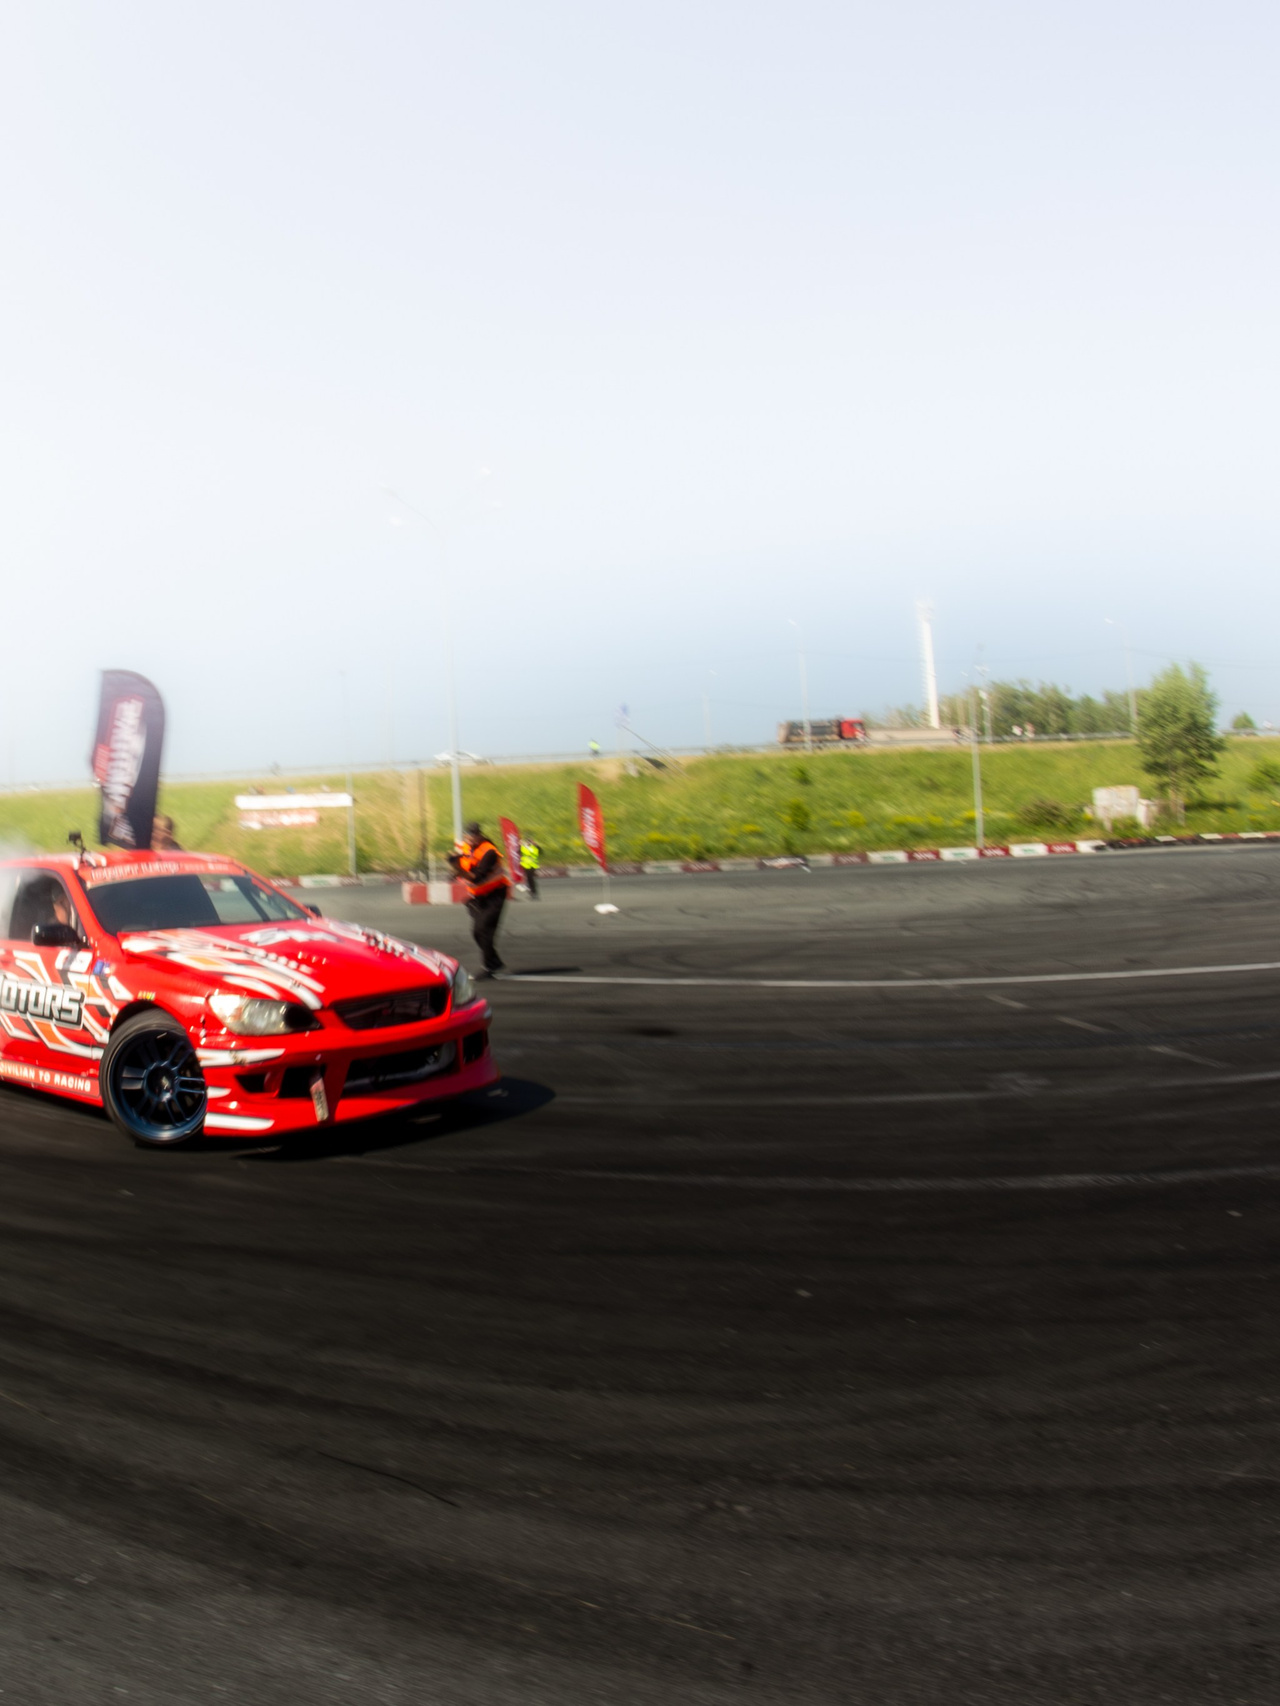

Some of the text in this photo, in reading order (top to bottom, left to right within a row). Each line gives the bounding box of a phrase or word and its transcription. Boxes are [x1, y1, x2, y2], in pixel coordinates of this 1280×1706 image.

[0, 1062, 35, 1079] CIVILIAN
[39, 1070, 51, 1083] TO
[54, 1073, 91, 1092] RACING
